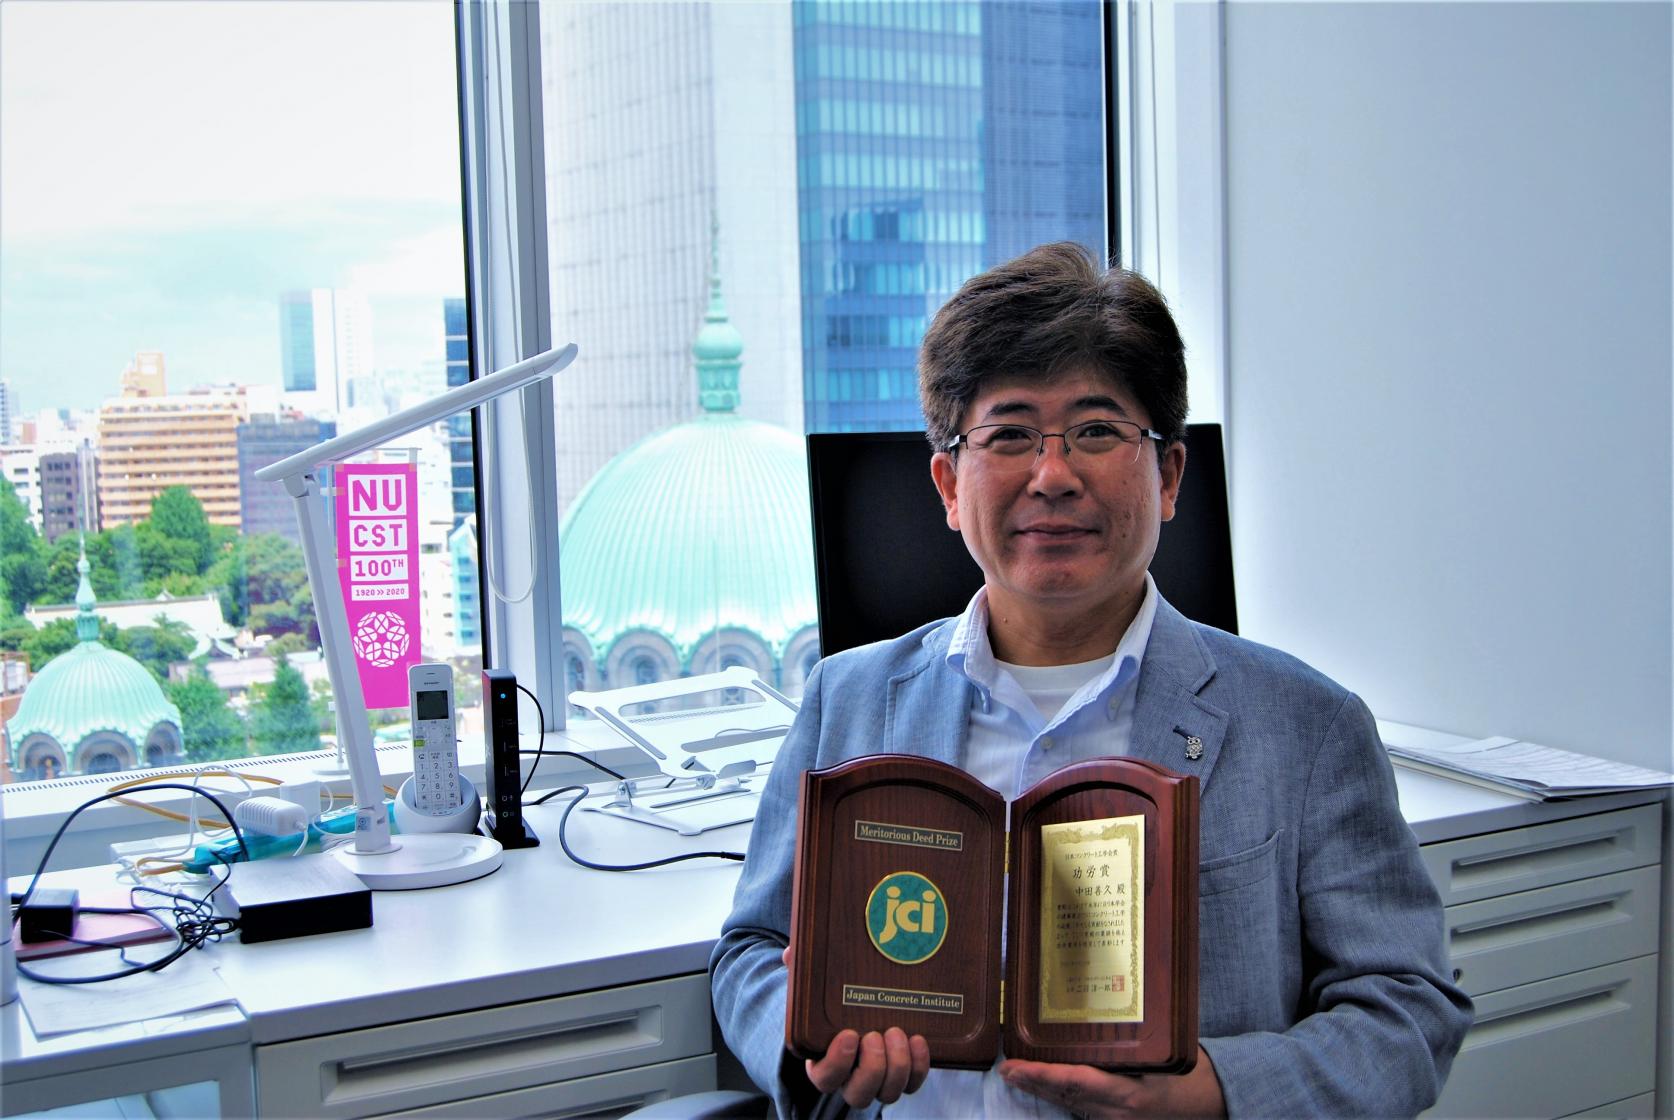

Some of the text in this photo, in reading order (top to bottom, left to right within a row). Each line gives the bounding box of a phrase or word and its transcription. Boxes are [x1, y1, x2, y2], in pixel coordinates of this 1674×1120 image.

[352, 478, 402, 512] NU
[353, 523, 403, 548] CST
[355, 587, 405, 597] 1920 2020
[860, 824, 958, 847] Meritorious Deed Prize
[879, 886, 937, 944] jci
[846, 989, 960, 1008] Japan Concrete Institute
